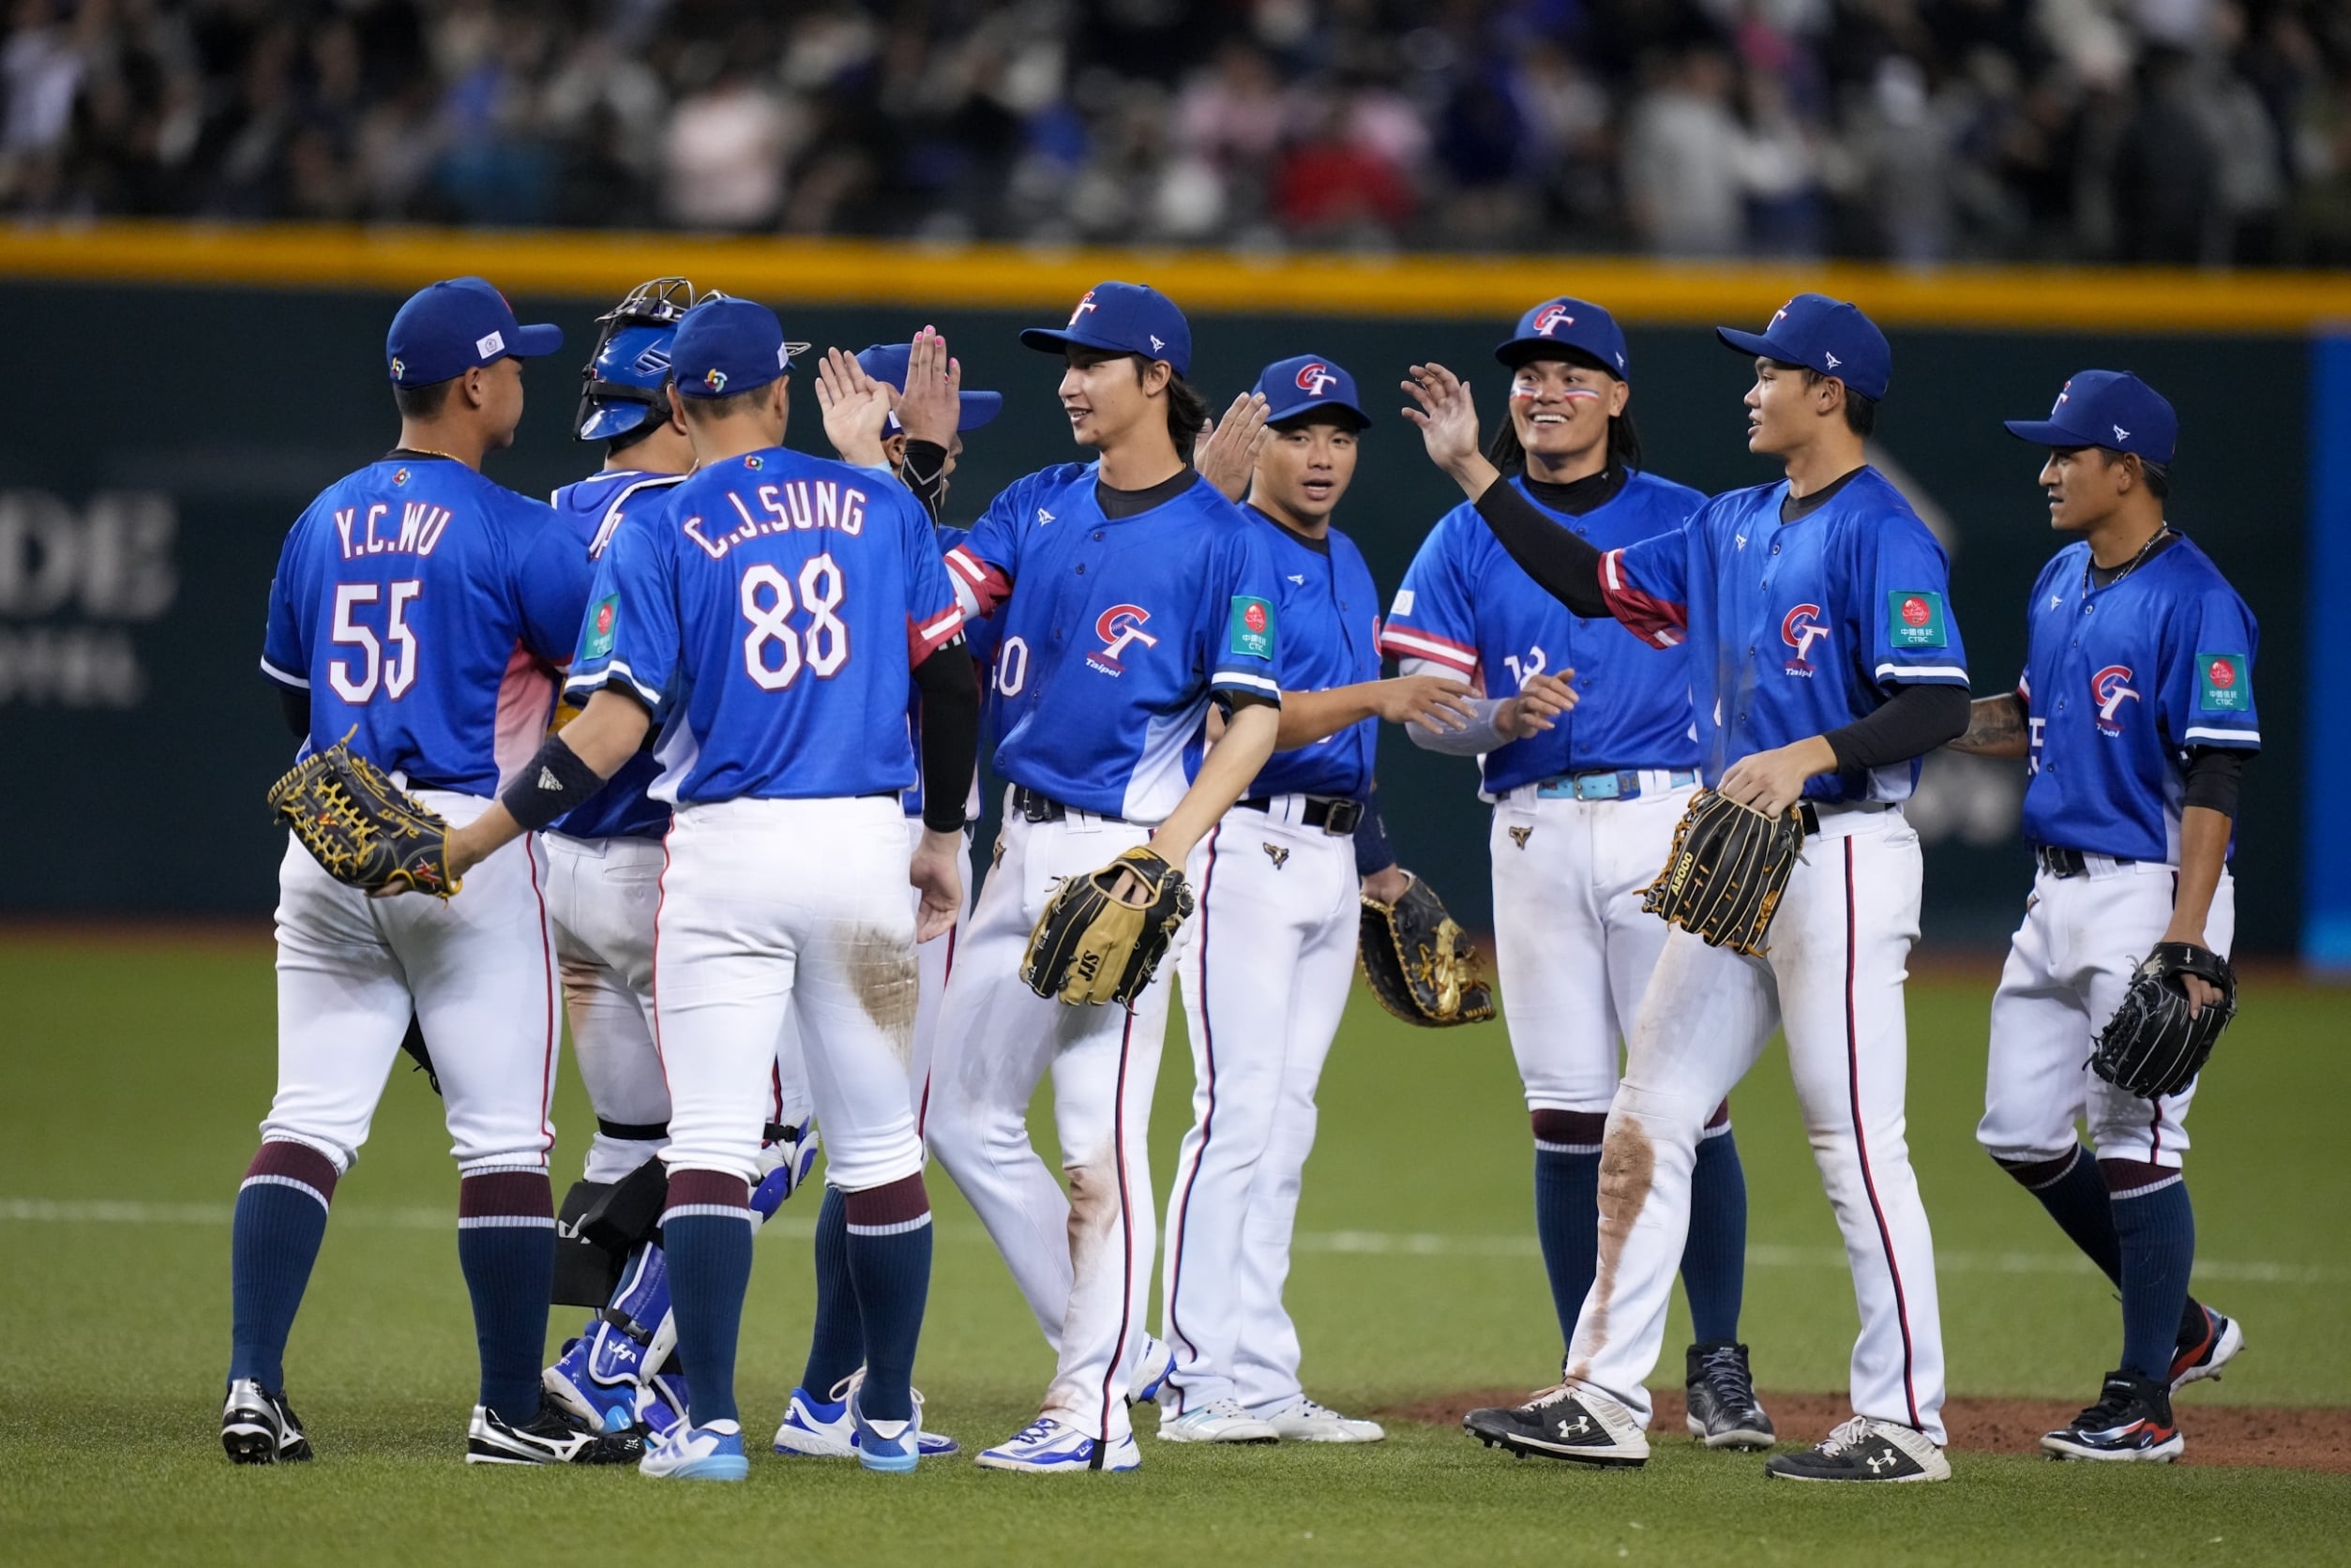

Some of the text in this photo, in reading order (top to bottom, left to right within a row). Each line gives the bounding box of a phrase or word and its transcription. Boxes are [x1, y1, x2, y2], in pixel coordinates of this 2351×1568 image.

[1295, 363, 1337, 397] CT
[335, 502, 451, 559] Y.C.WU
[684, 480, 867, 559] C.J.SUNG
[329, 580, 420, 702] 55
[740, 552, 848, 690] 88
[1095, 603, 1158, 660] CT
[1781, 603, 1830, 661] CT
[991, 636, 1029, 697] 0
[1085, 658, 1122, 678] Taipei
[2091, 665, 2140, 721] CT
[1671, 852, 1694, 897] A2000
